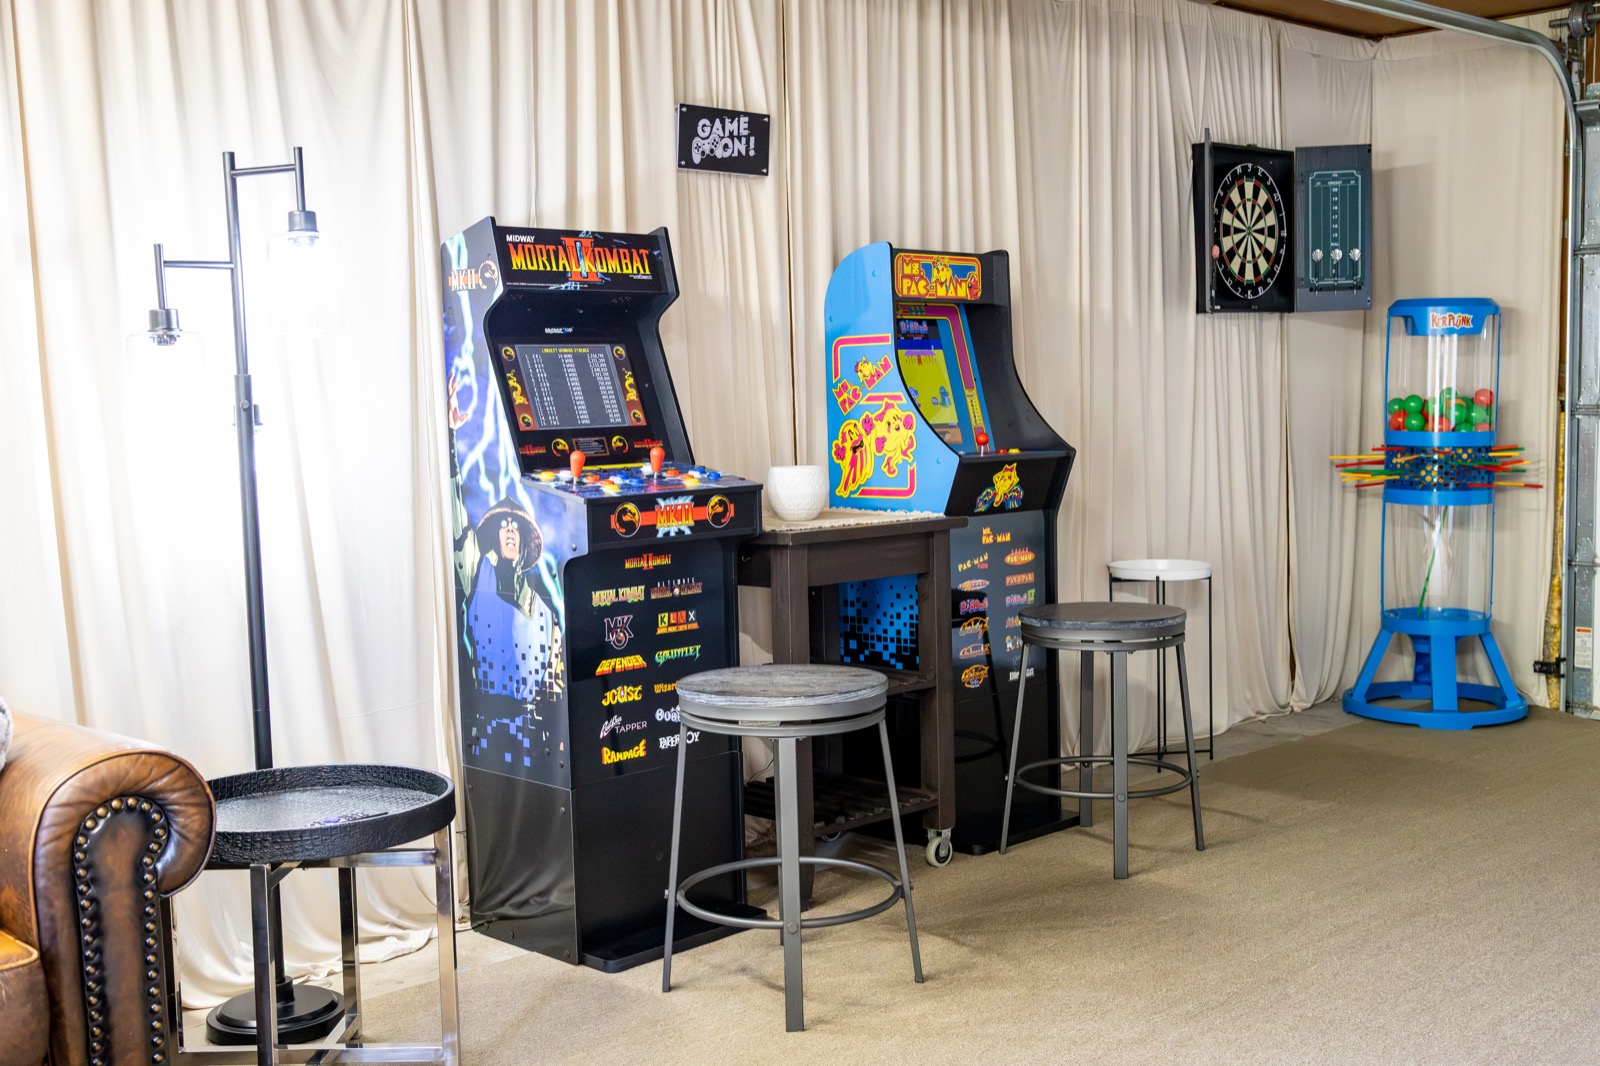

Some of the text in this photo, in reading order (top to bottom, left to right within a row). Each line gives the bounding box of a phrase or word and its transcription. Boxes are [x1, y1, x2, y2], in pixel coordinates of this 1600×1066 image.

[697, 115, 750, 138] GAME
[720, 136, 755, 158] ON!
[506, 234, 535, 243] MIDWAY
[508, 243, 582, 272] MORTAL
[581, 246, 651, 275] KOMBAT
[902, 256, 924, 276] MS.
[451, 269, 476, 291] MKII
[902, 277, 967, 298] PAC-MAN
[656, 501, 694, 529] MKII
[982, 532, 1011, 544] PAC-MAN
[625, 556, 650, 569] MORTAL
[649, 554, 671, 567] KOMBAT
[958, 552, 988, 572] PAC-MAN
[1007, 553, 1032, 563] PAC-MAN
[592, 585, 645, 606] MORTAL KOMBAT
[595, 654, 647, 676] DEFENDER
[654, 645, 701, 667] GAUNTLET
[602, 685, 642, 706] JOUST
[614, 721, 647, 734] TAPPER
[659, 731, 700, 749] PAPEROY
[602, 739, 646, 764] RAMPAGE
